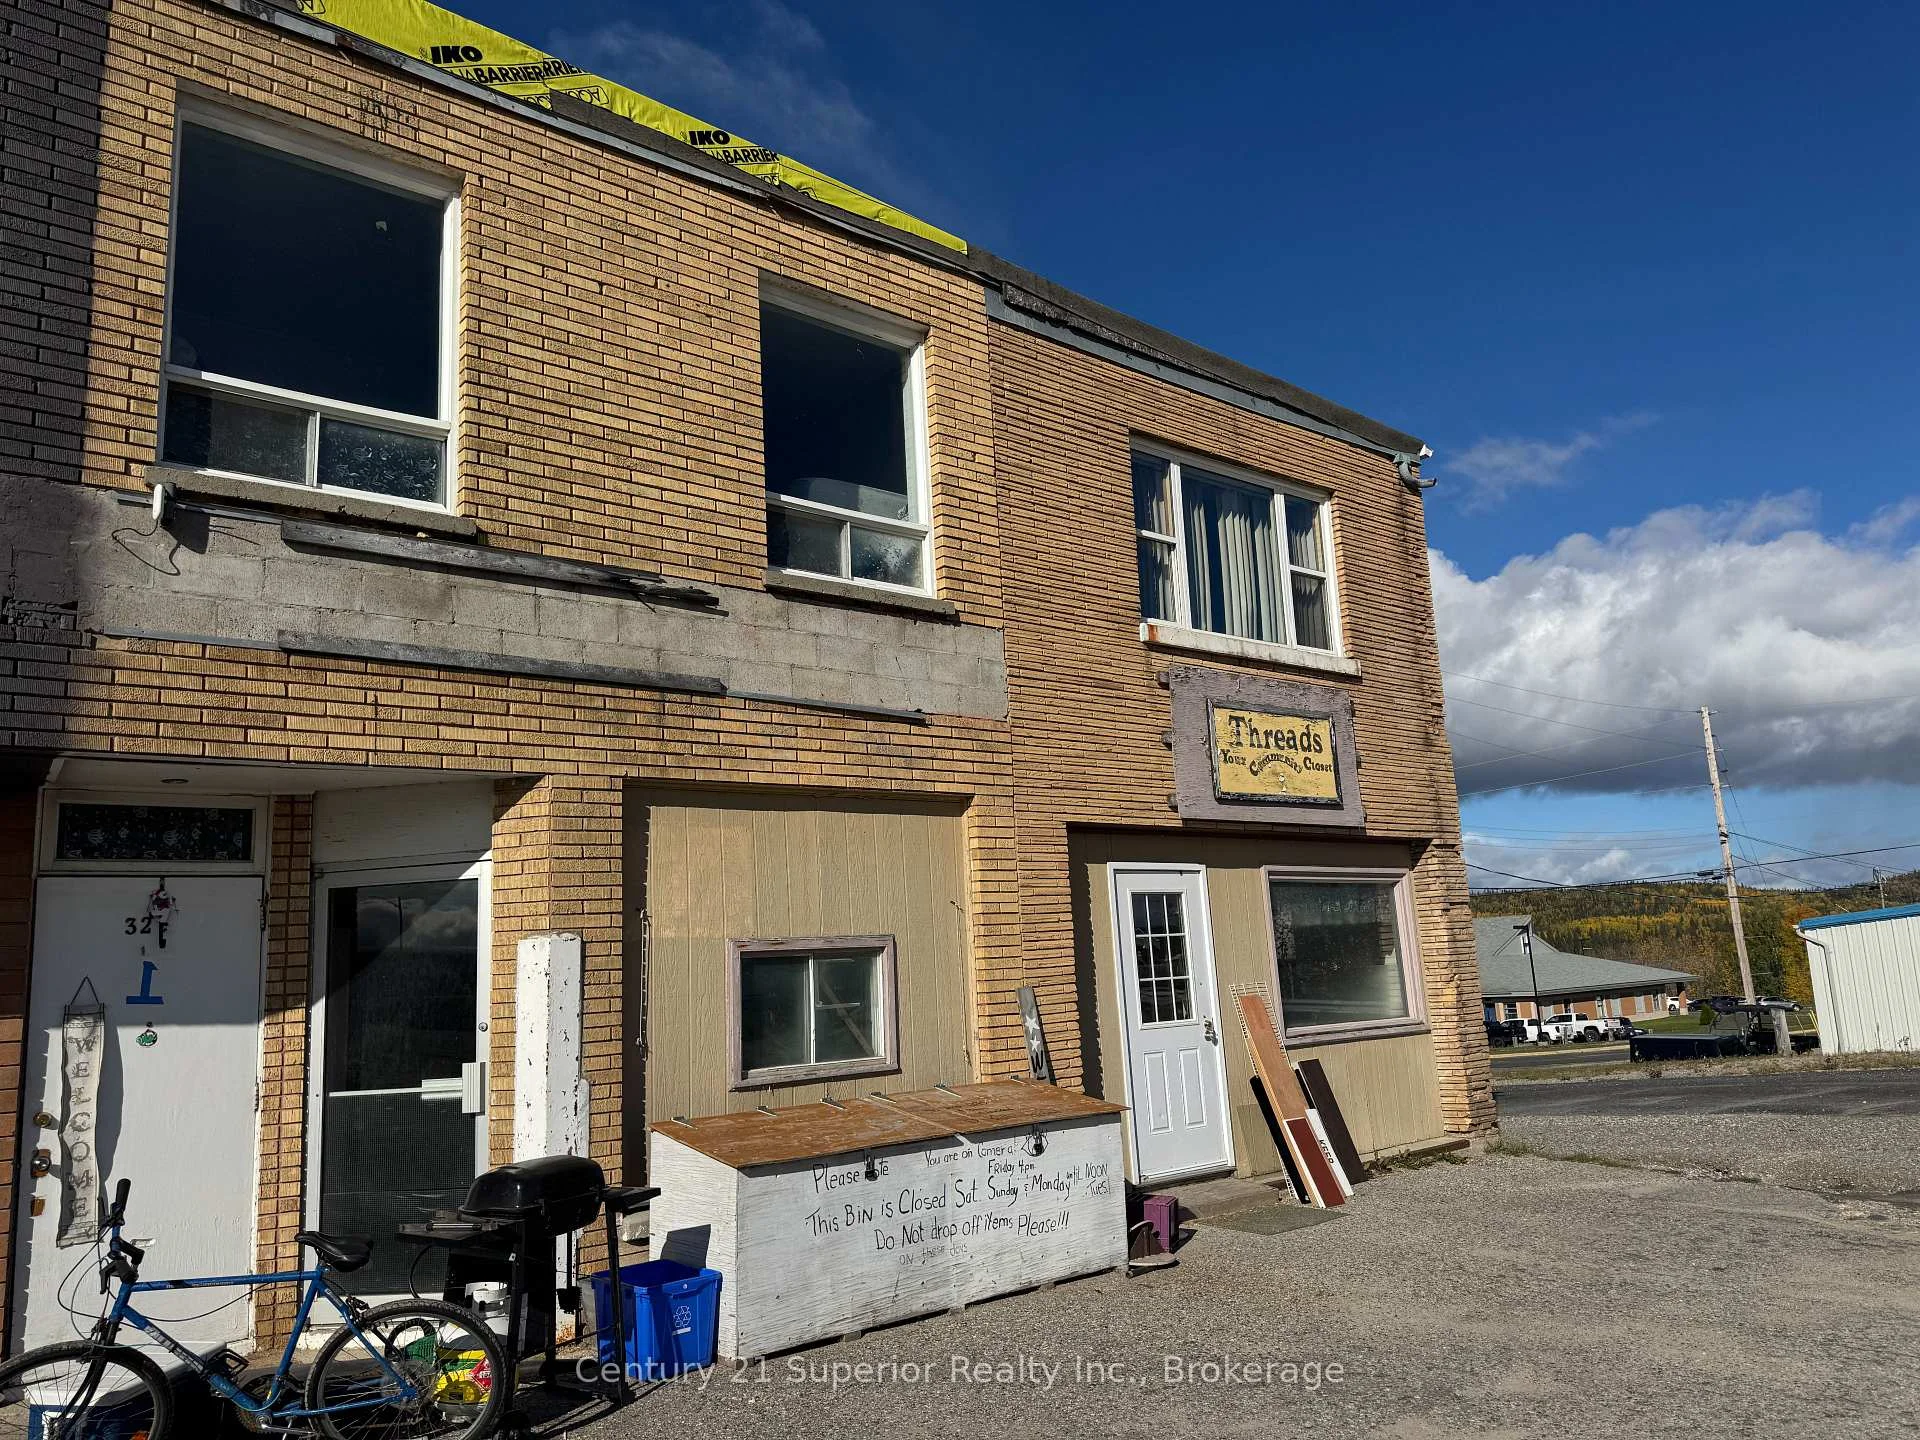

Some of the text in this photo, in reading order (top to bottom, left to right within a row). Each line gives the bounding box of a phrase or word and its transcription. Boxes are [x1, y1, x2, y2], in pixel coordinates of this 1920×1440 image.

[430, 45, 483, 64] IKO
[689, 130, 731, 146] IKO
[1228, 714, 1323, 754] Threads
[125, 916, 152, 935] 32
[925, 1148, 941, 1168] You
[943, 1152, 959, 1163] are
[961, 1148, 973, 1158] on
[813, 1163, 860, 1193] Please
[805, 1207, 839, 1237] This
[881, 1199, 894, 1218] is
[899, 1183, 946, 1214] Closed
[987, 1175, 1018, 1207] Sunday
[1032, 1170, 1071, 1201] Monday
[874, 1228, 895, 1250] Do
[901, 1221, 924, 1248] Not
[931, 1215, 958, 1243] drop
[962, 1214, 983, 1236] off
[984, 1211, 1013, 1232] items
